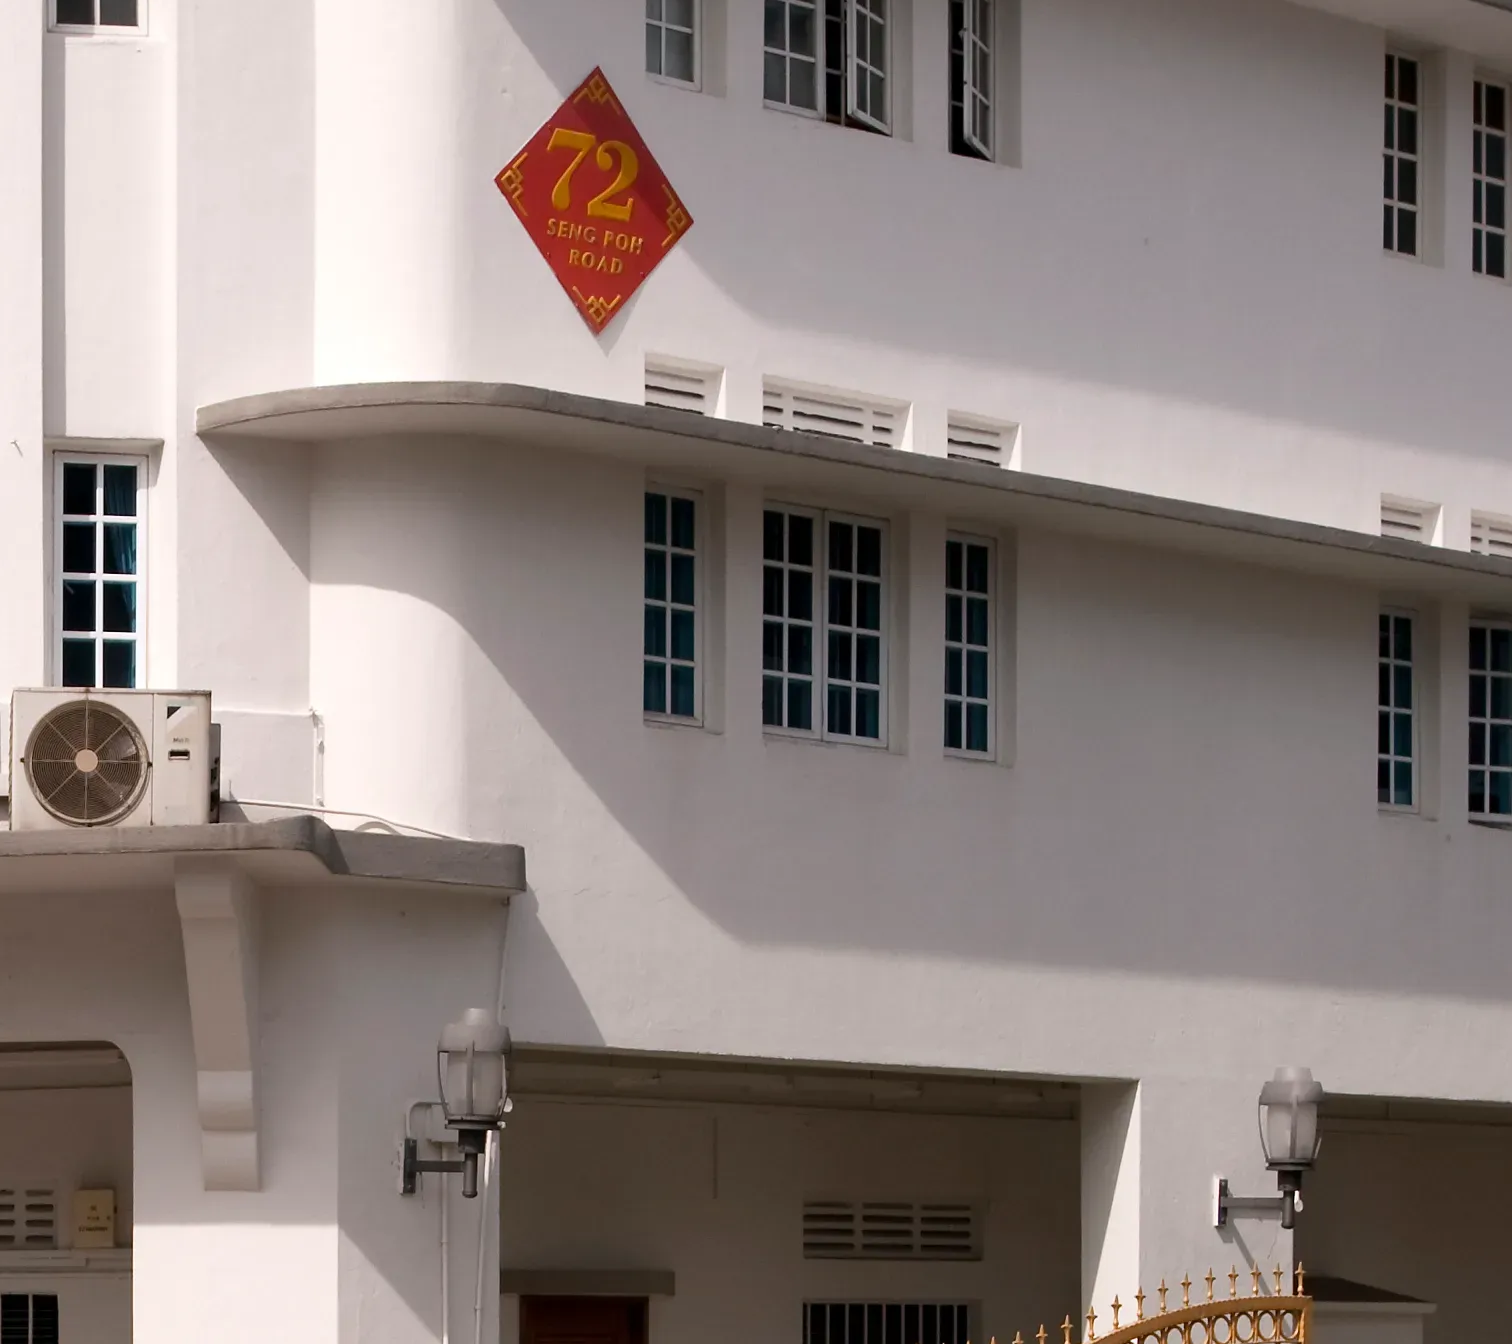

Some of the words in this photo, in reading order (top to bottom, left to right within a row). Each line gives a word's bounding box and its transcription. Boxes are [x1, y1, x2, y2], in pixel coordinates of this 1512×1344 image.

[546, 127, 639, 222] 72
[546, 217, 597, 243] SENG
[603, 229, 644, 256] POH
[568, 248, 624, 275] ROAD
